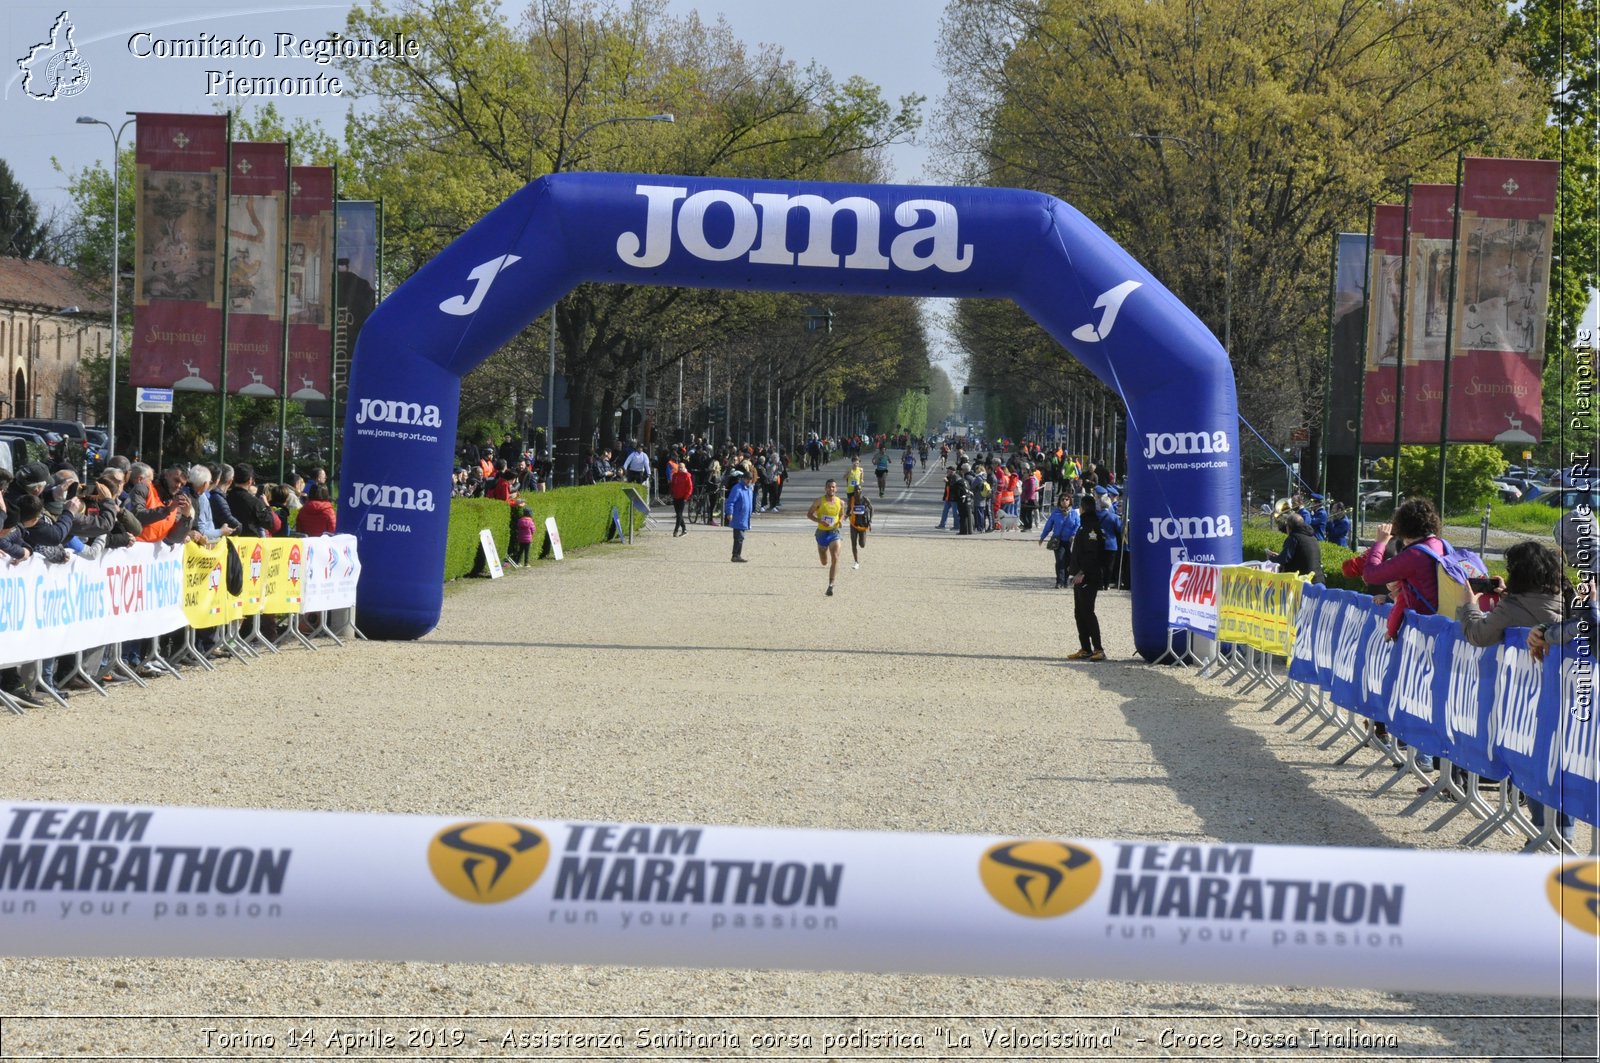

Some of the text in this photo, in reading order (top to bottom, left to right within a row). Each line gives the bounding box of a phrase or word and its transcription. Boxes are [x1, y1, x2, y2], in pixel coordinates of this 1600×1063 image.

[616, 184, 975, 273] Joma
[145, 324, 208, 344] Stupinigi
[1464, 375, 1529, 397] Stupinigi
[355, 398, 442, 428] Joma
[357, 428, 438, 442] www.joma-sport.com
[1143, 430, 1230, 459] Joma
[1147, 460, 1228, 471] www.joma-sport.com
[348, 482, 435, 512] Joma
[386, 523, 411, 533] JOMA
[1147, 514, 1233, 544] Joma
[1191, 553, 1216, 562] JOMA
[146, 560, 181, 609] HYBRID
[6, 807, 154, 842] TEAM
[564, 824, 703, 856] TEAM
[0, 843, 292, 895] MARATHON
[1113, 842, 1254, 874] TEAM
[552, 857, 844, 907] MARATHON
[0, 898, 282, 919] un your passion
[1108, 874, 1405, 926] MARATHON
[549, 909, 838, 931] run your passion
[1105, 923, 1404, 948] run your passion
